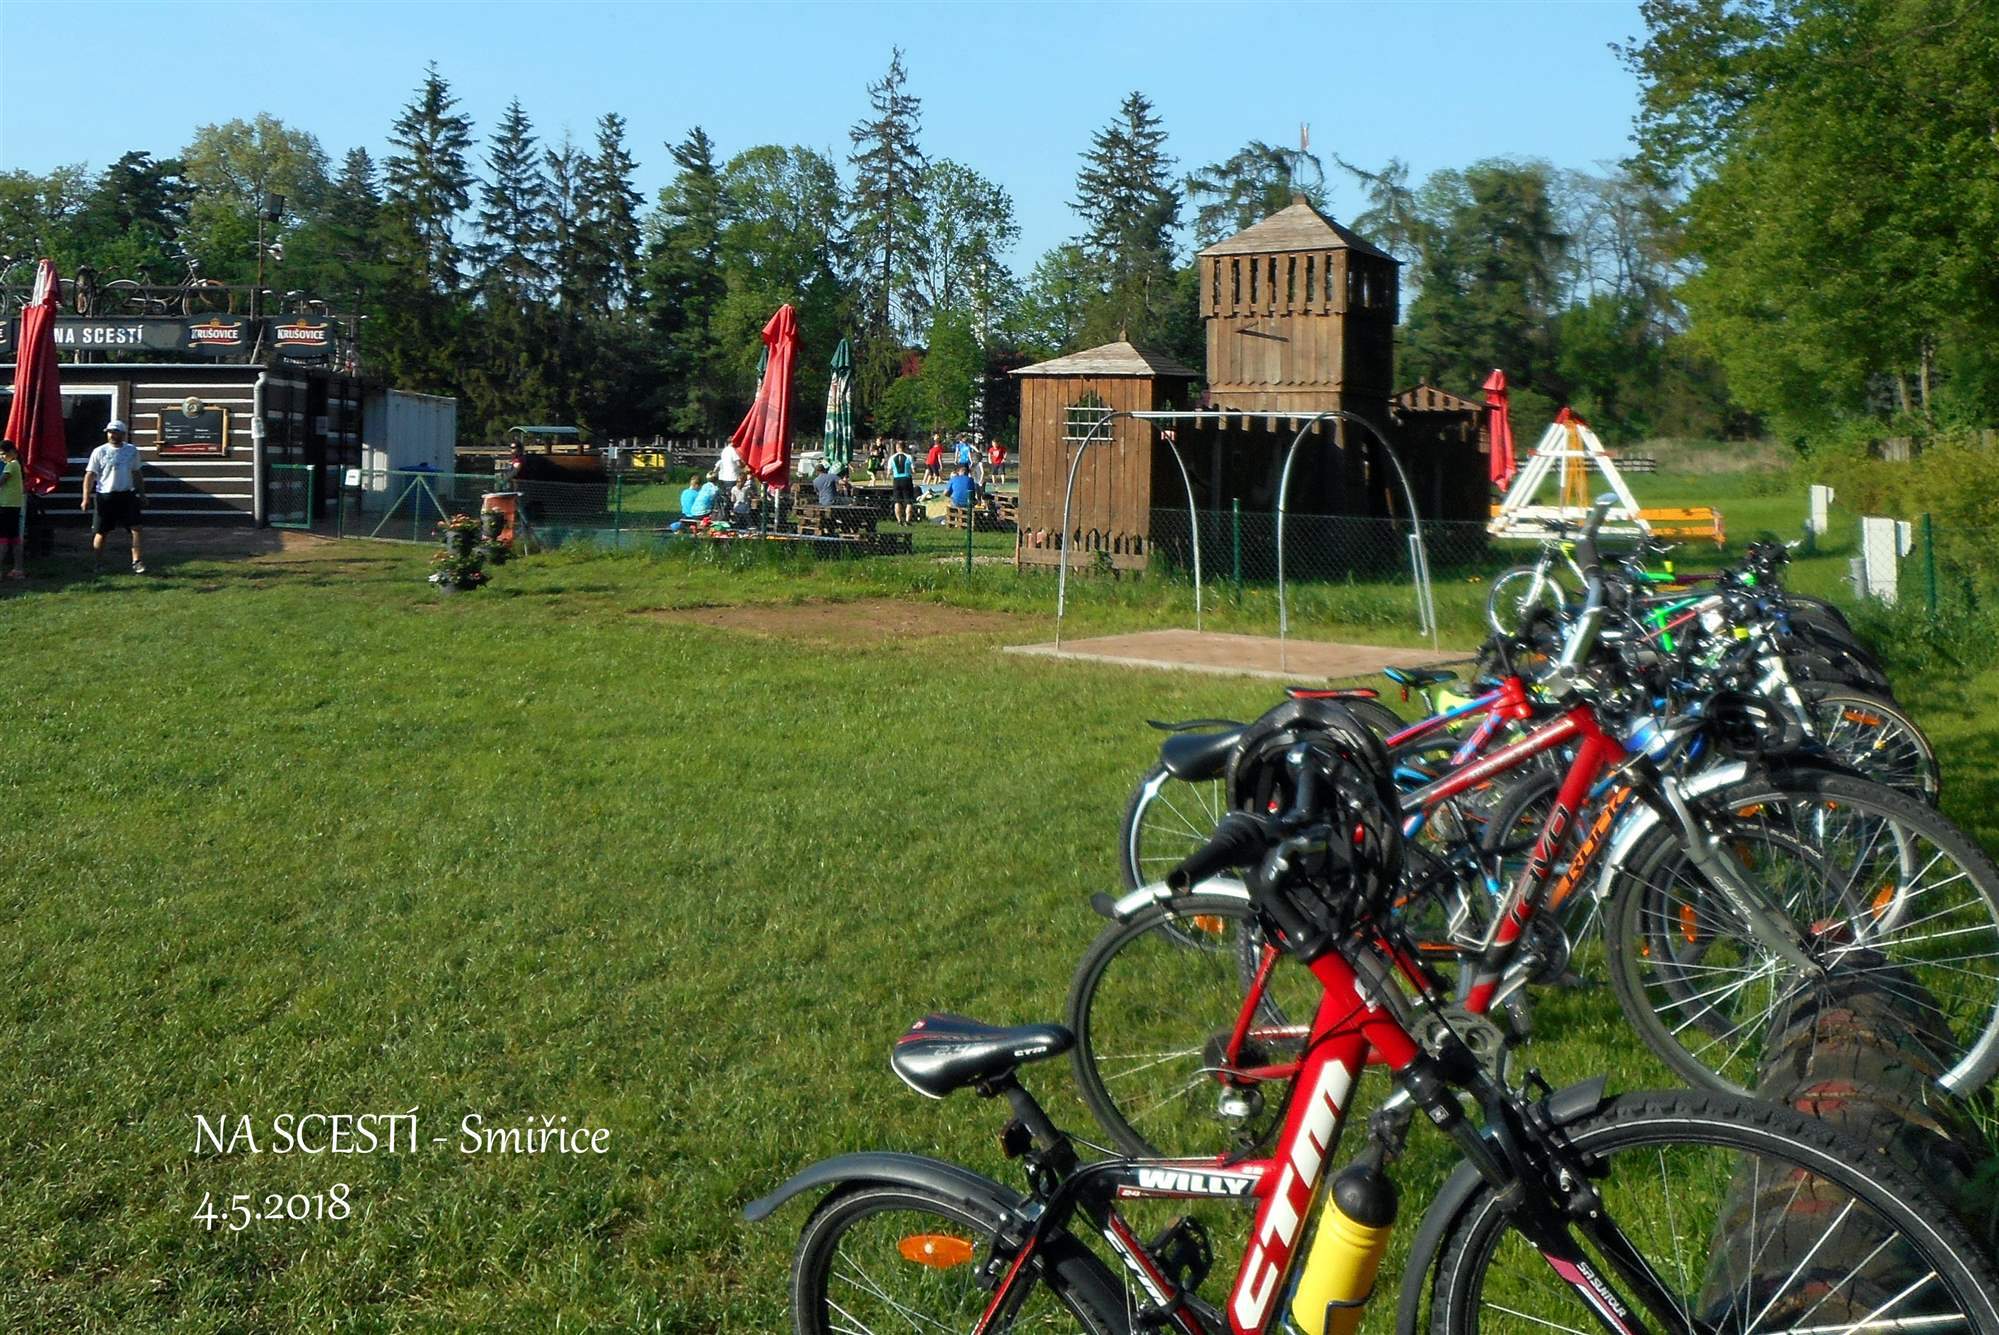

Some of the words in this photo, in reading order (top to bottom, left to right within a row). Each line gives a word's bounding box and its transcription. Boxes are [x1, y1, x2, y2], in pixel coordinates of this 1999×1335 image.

[54, 328, 75, 343] NA
[83, 325, 144, 343] SCESTÍ
[191, 328, 238, 339] KRUŠOVICE
[277, 328, 325, 340] KRUŠOVICE
[1138, 1169, 1249, 1195] WILLY
